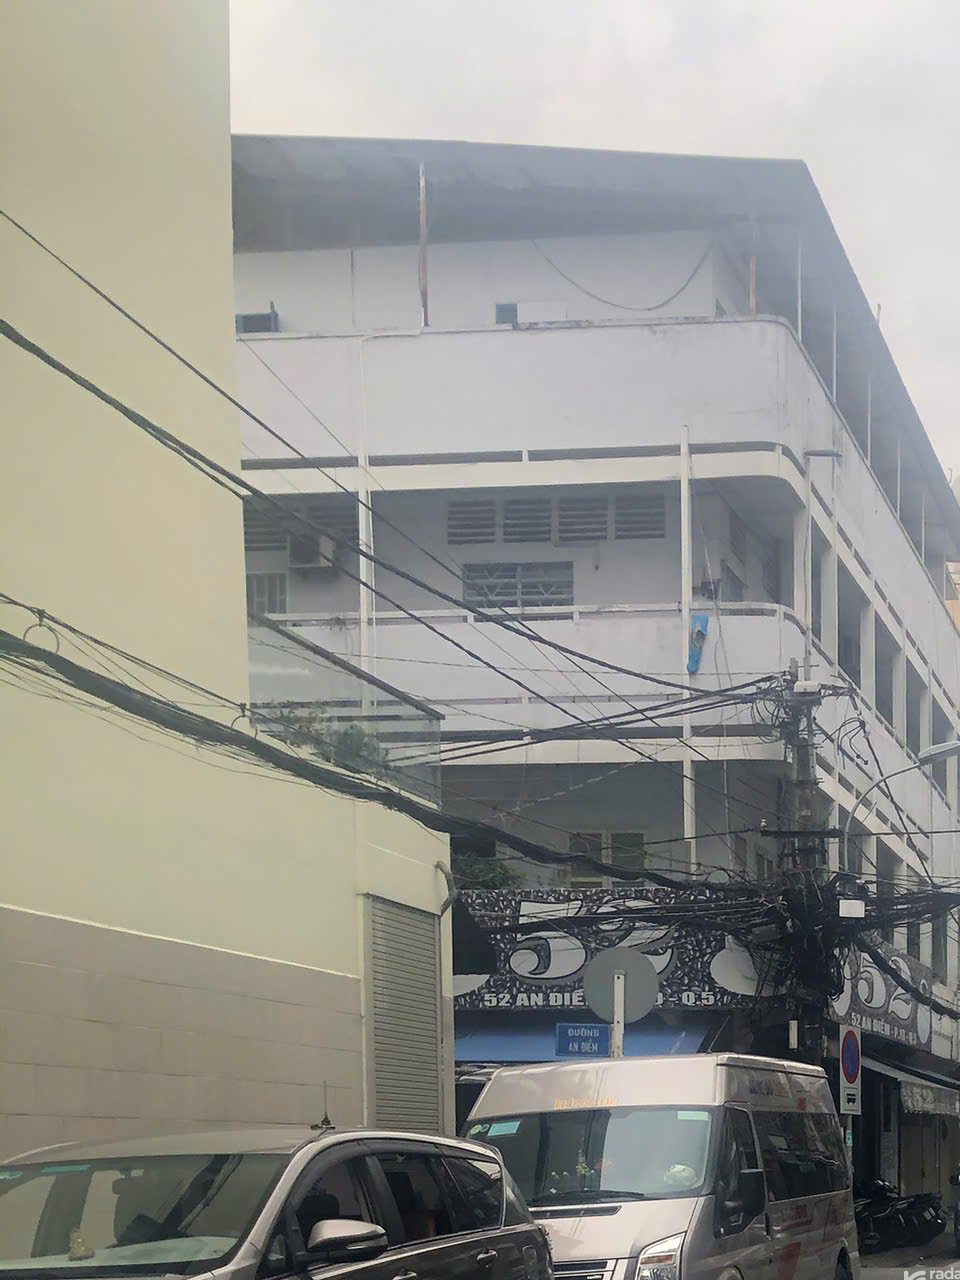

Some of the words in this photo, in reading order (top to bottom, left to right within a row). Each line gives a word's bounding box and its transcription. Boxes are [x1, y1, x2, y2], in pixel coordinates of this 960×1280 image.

[509, 898, 675, 981] 52
[483, 993, 511, 1007] 52
[515, 992, 543, 1006] AN
[549, 988, 587, 1006] ĐIỂ
[681, 991, 715, 1006] Q.5
[857, 951, 913, 1021] 52
[568, 1041, 579, 1052] AN
